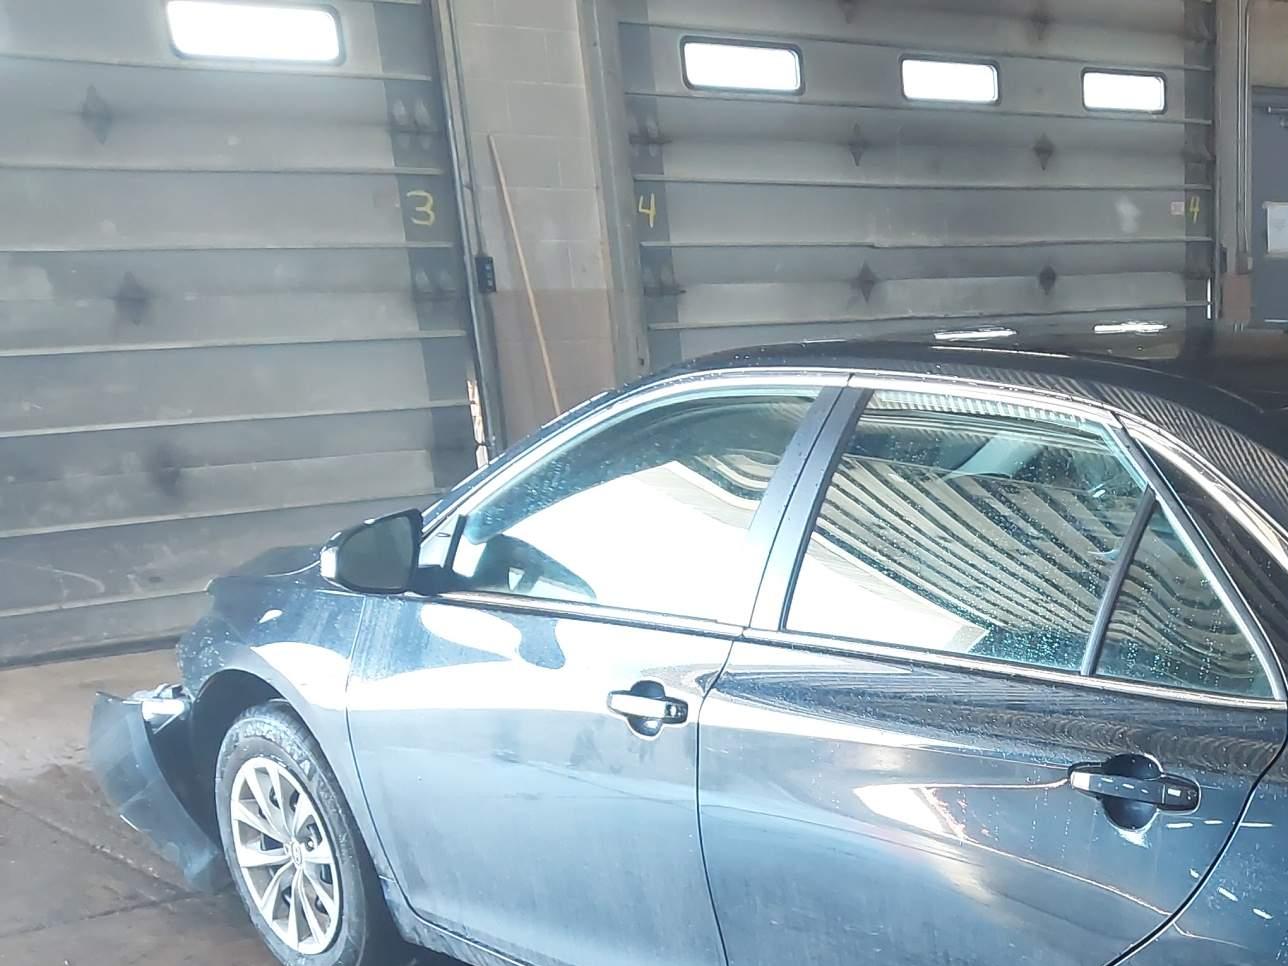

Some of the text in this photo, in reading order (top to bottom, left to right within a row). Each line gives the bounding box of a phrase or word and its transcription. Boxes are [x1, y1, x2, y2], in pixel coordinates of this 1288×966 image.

[406, 190, 436, 226] 3
[638, 192, 656, 228] 4
[1189, 195, 1200, 224] 4
